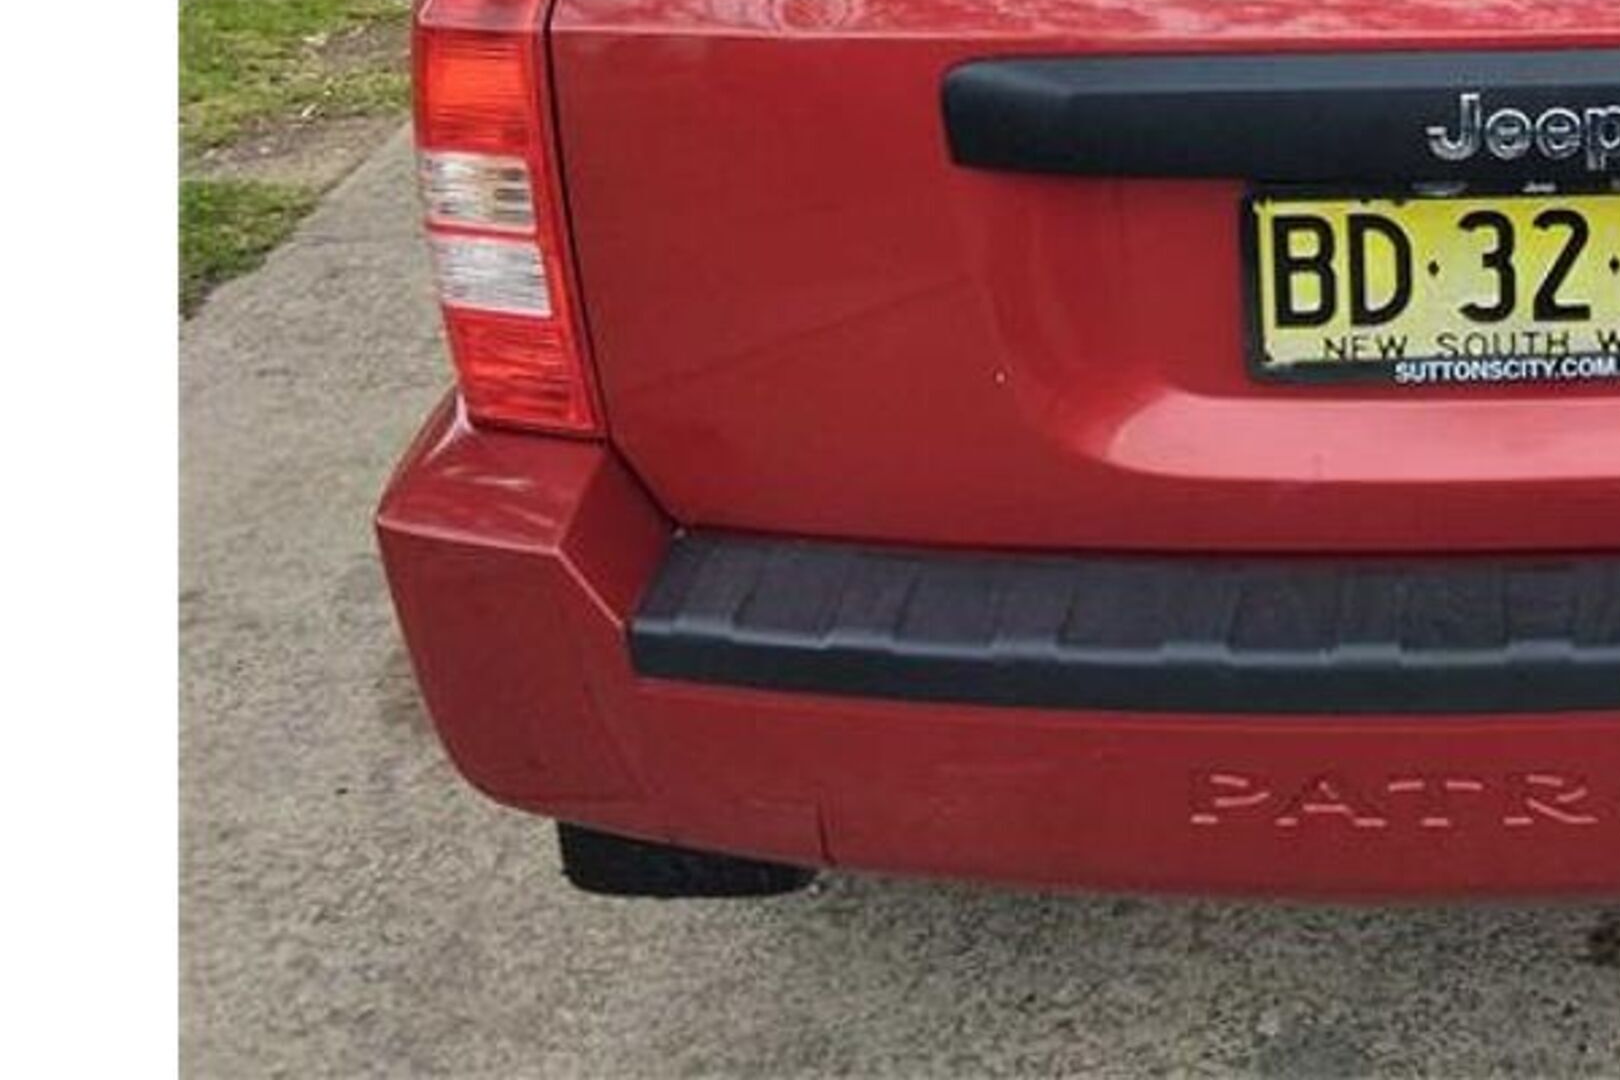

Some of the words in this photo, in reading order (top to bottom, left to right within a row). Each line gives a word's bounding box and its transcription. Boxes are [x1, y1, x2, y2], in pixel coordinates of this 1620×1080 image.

[1457, 210, 1592, 321] 32
[1323, 335, 1409, 360] NEW
[1437, 330, 1570, 357] SOUTH
